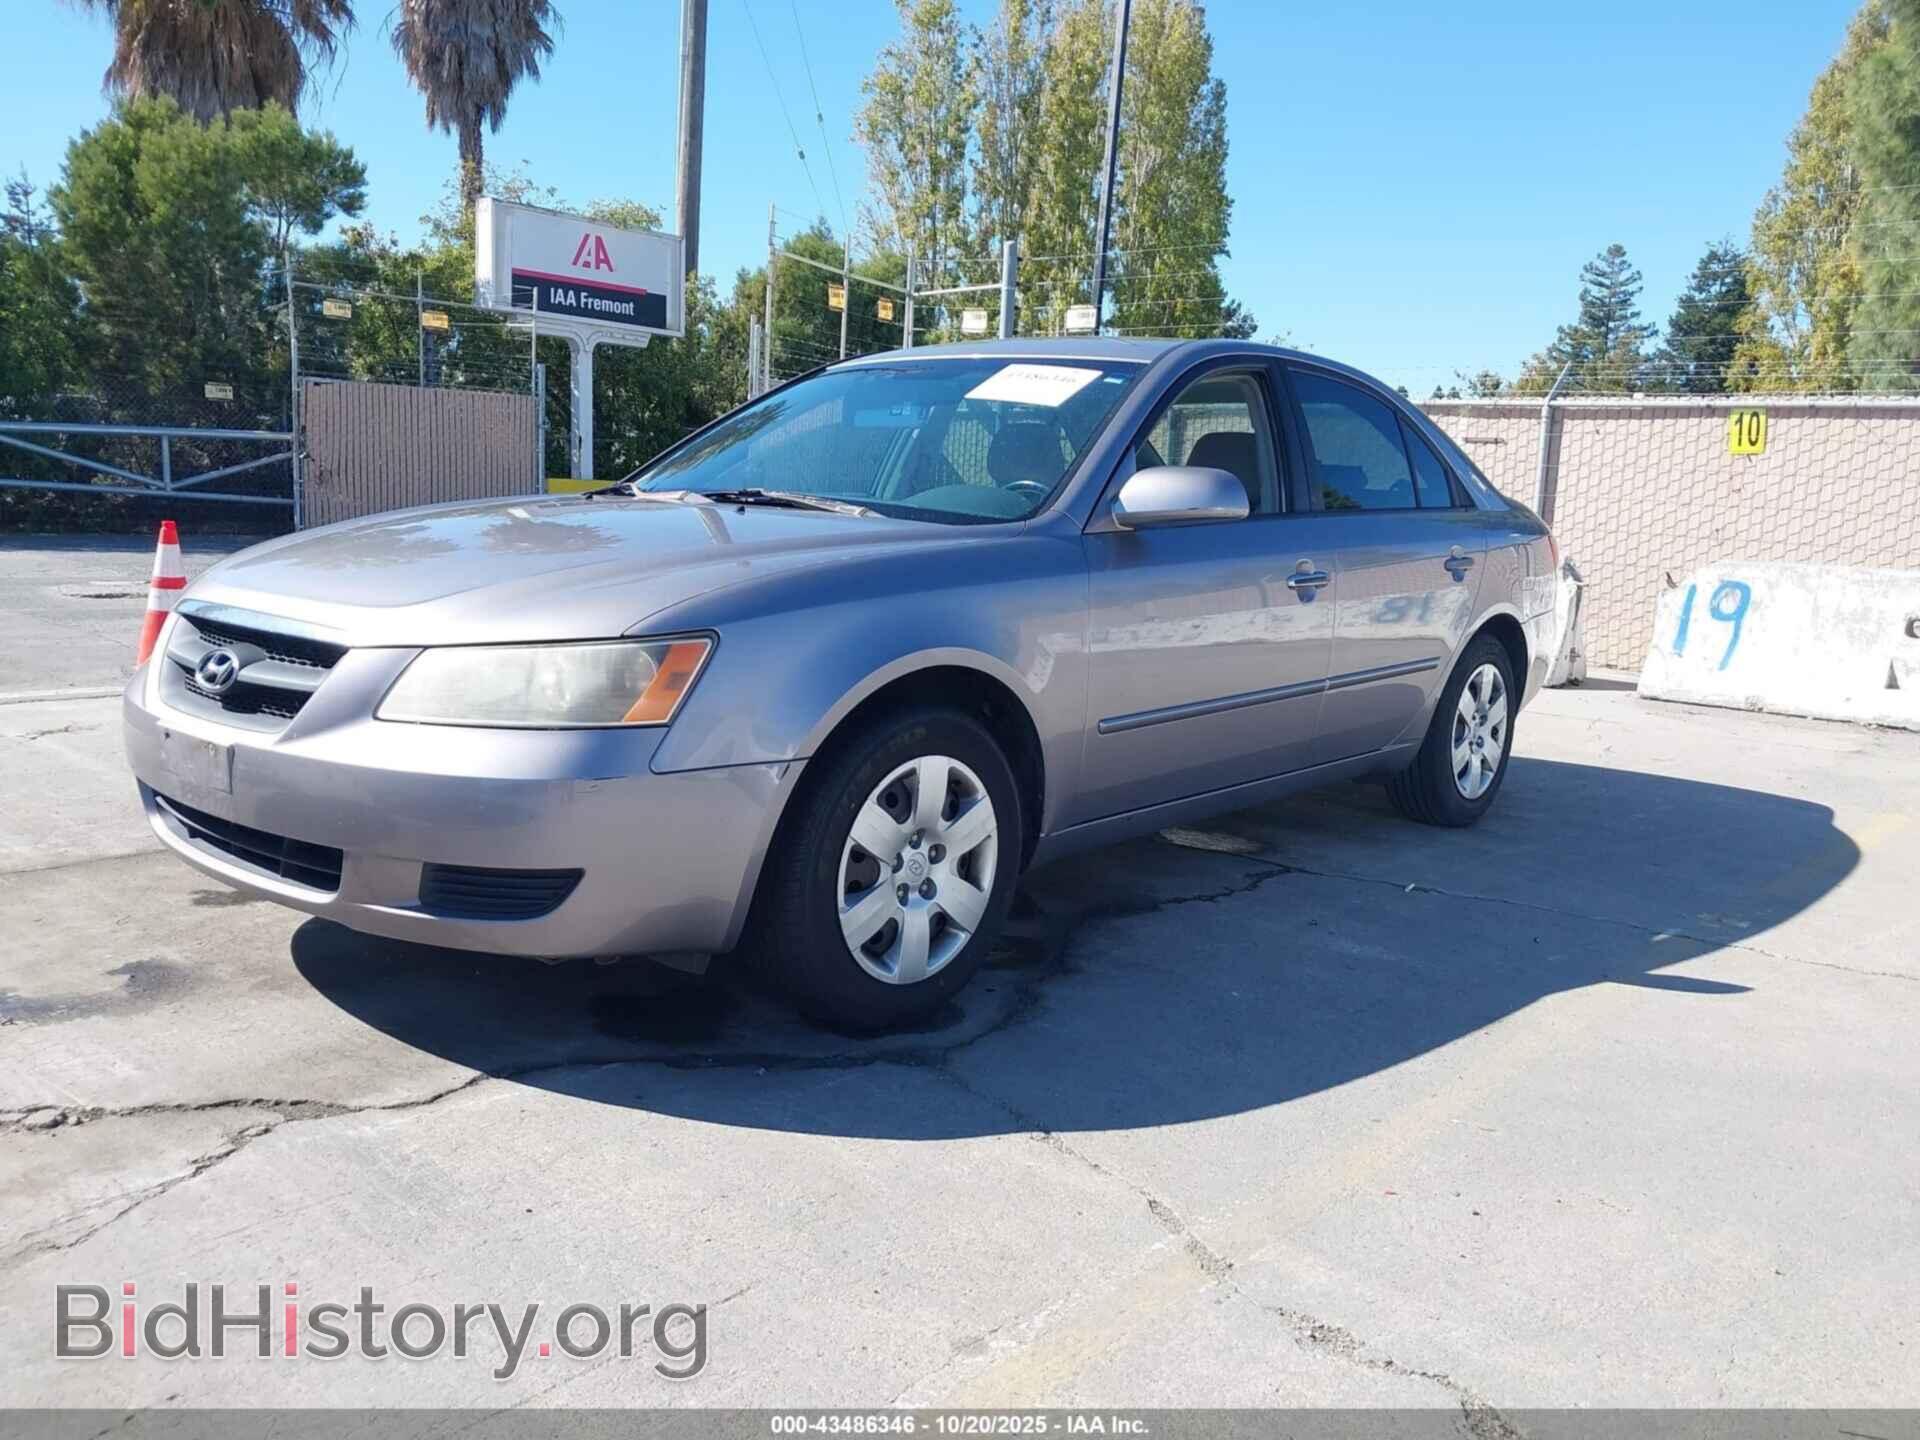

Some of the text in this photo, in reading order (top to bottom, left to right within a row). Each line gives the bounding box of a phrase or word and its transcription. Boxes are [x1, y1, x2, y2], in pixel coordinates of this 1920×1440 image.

[550, 287, 635, 316] IAA Fremont
[1735, 410, 1760, 447] 10
[1672, 578, 1751, 671] 19
